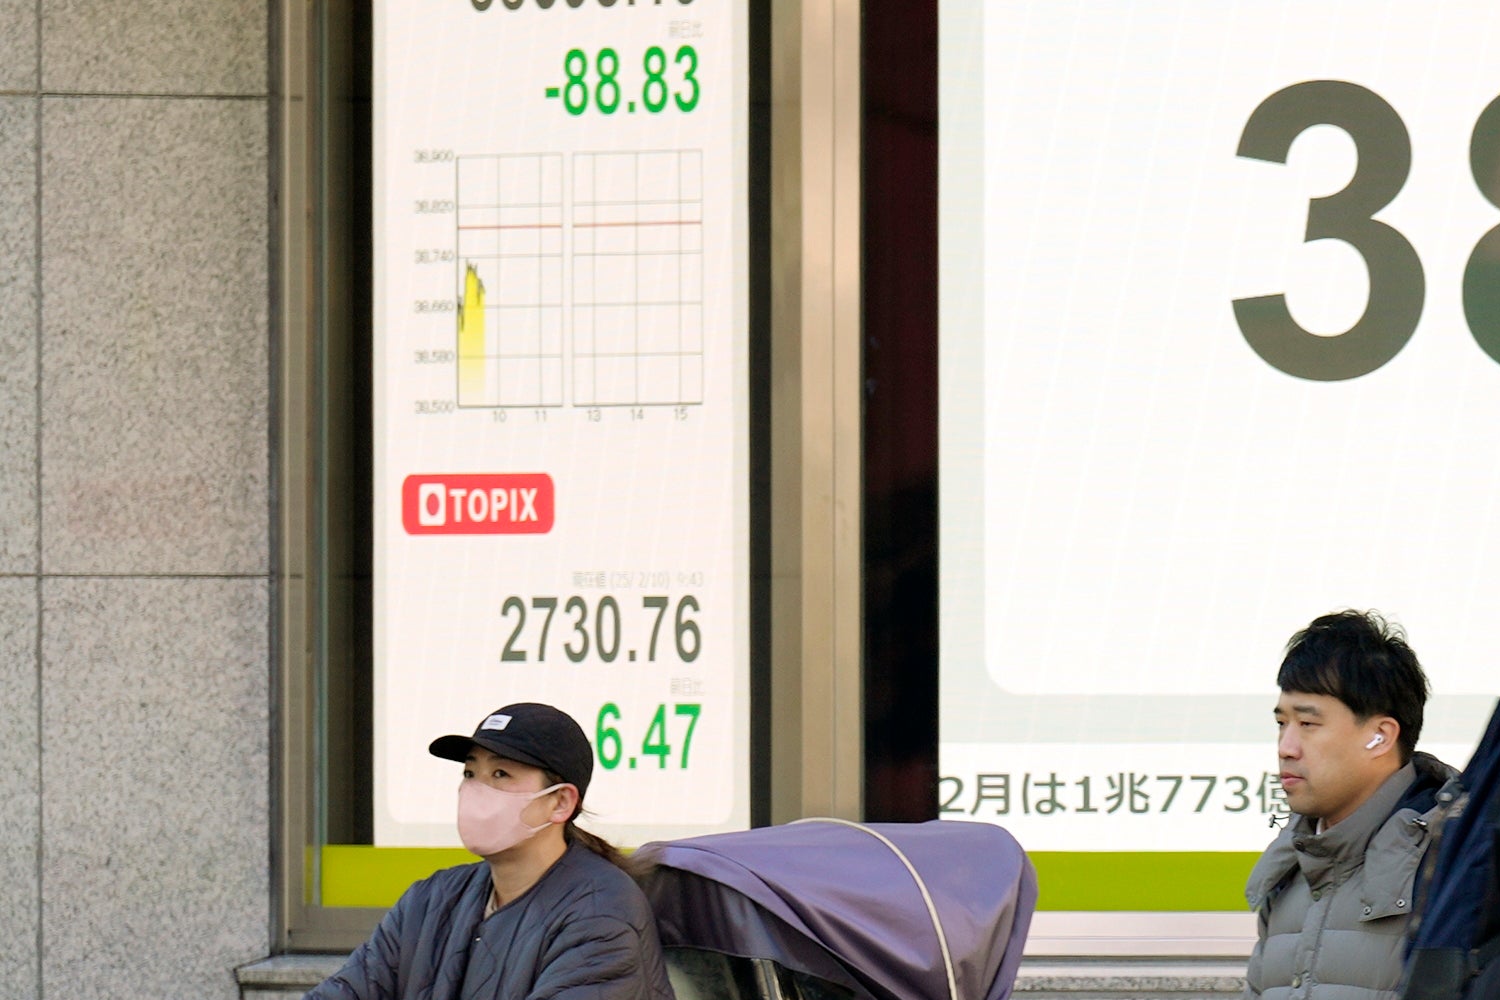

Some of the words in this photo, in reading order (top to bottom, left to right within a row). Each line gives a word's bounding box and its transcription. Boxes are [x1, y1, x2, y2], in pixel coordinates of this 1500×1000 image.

[545, 45, 701, 115] -88.83
[449, 488, 538, 522] TOPIX
[500, 595, 701, 663] 2730.76
[589, 702, 701, 769] 6.47
